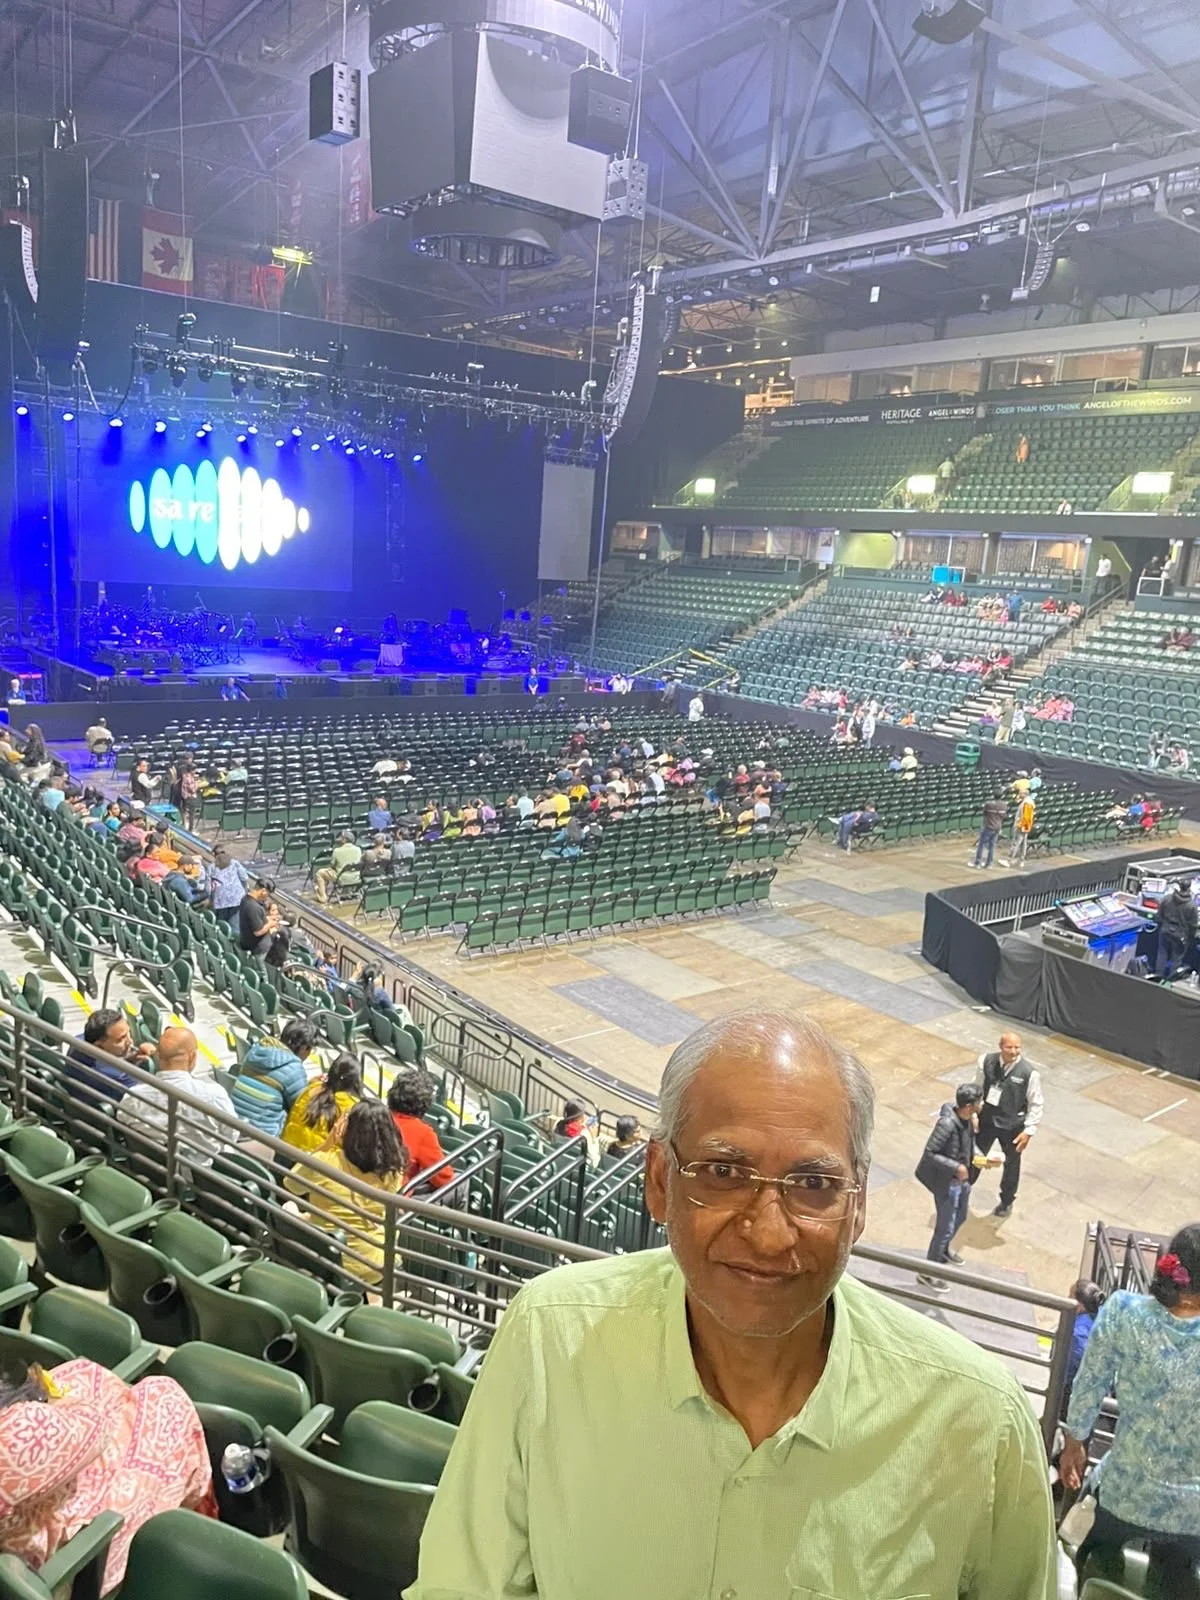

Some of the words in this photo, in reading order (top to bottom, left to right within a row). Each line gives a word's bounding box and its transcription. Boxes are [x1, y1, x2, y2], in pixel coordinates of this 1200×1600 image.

[1016, 405, 1038, 413] THAN
[1039, 404, 1055, 413] YOU
[1056, 402, 1081, 411] THINK
[1083, 396, 1192, 409] ANGELOFTHEWINDS.COM
[881, 408, 921, 420] HERITAGE
[953, 407, 975, 416] WINDS
[835, 415, 869, 423] ADVENTURE
